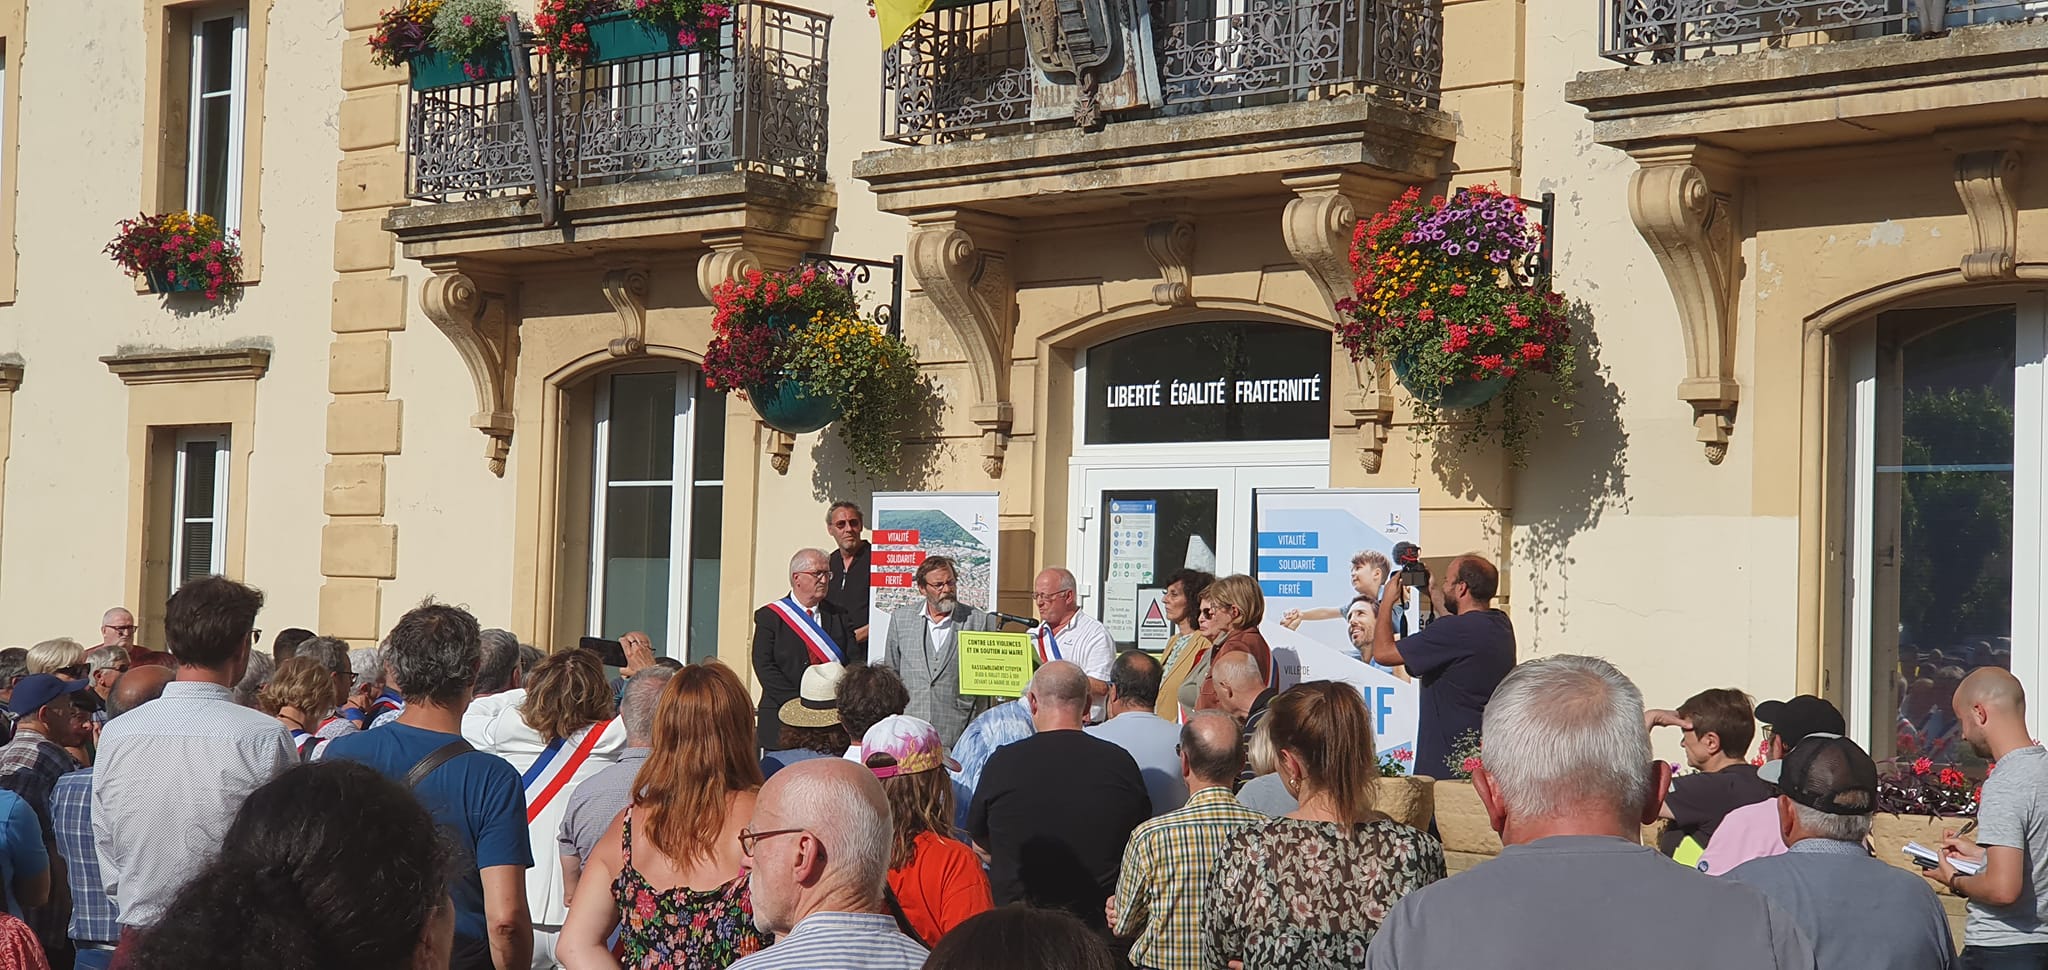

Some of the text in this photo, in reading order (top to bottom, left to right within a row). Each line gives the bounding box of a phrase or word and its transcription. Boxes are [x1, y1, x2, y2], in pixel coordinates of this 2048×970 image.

[1107, 373, 1321, 408] LIBERTÉ ÉGALITÉ FRATERNITÉ
[887, 532, 909, 543] VITALITÉ
[1278, 533, 1307, 546] VITALITÉ
[886, 553, 916, 564] SOLIDARITÉ
[1278, 557, 1317, 571] SOLIDARITÉ
[885, 574, 903, 585] FIERTÉ
[1278, 581, 1301, 595] FIERTÉ
[996, 640, 1021, 648] VIOLENCES
[980, 647, 1001, 655] SOUTIEN
[1284, 665, 1310, 676] VILLE DE
